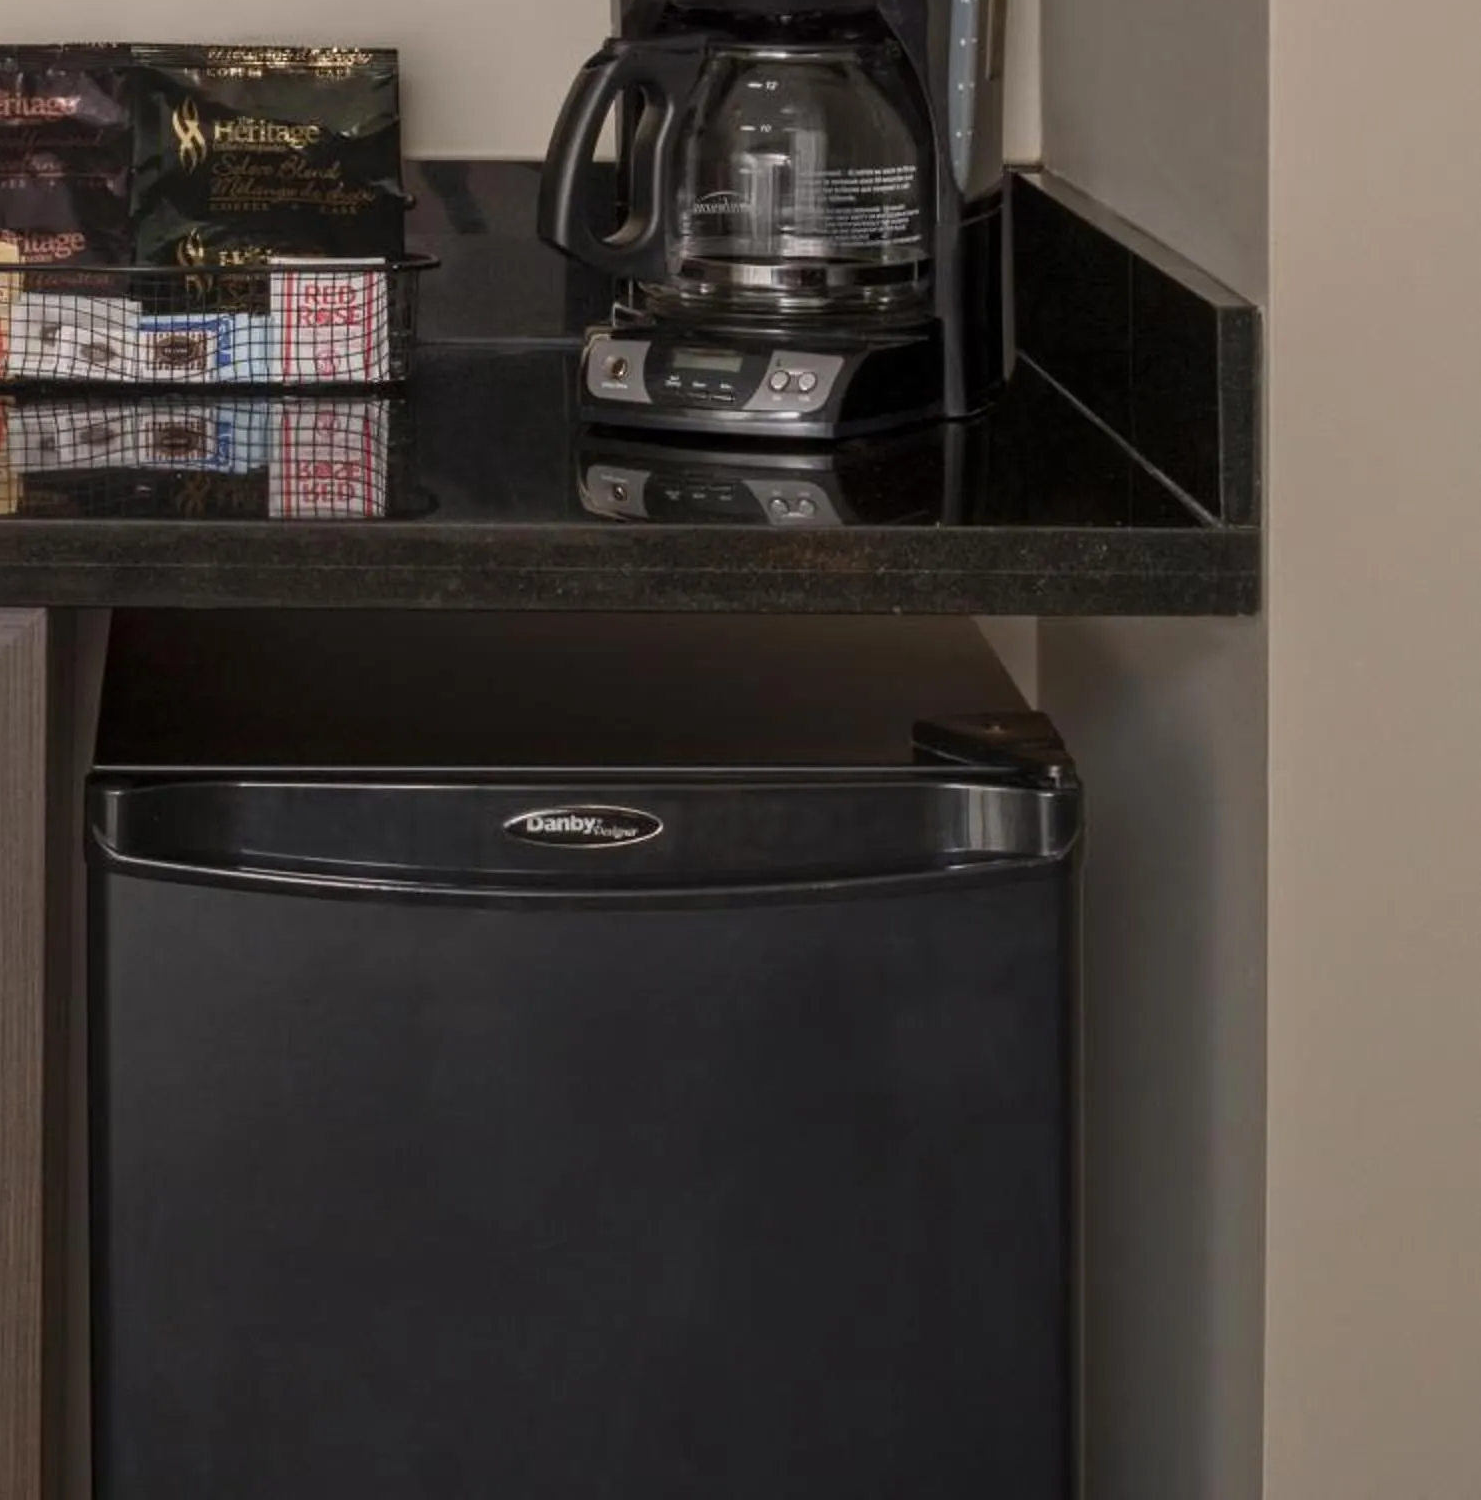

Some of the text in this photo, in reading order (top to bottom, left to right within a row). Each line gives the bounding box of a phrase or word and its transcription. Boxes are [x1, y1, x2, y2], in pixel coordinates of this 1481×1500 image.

[213, 119, 320, 149] Heritage
[304, 285, 356, 304] RED
[298, 306, 362, 326] ROSE
[526, 815, 596, 834] Danby
